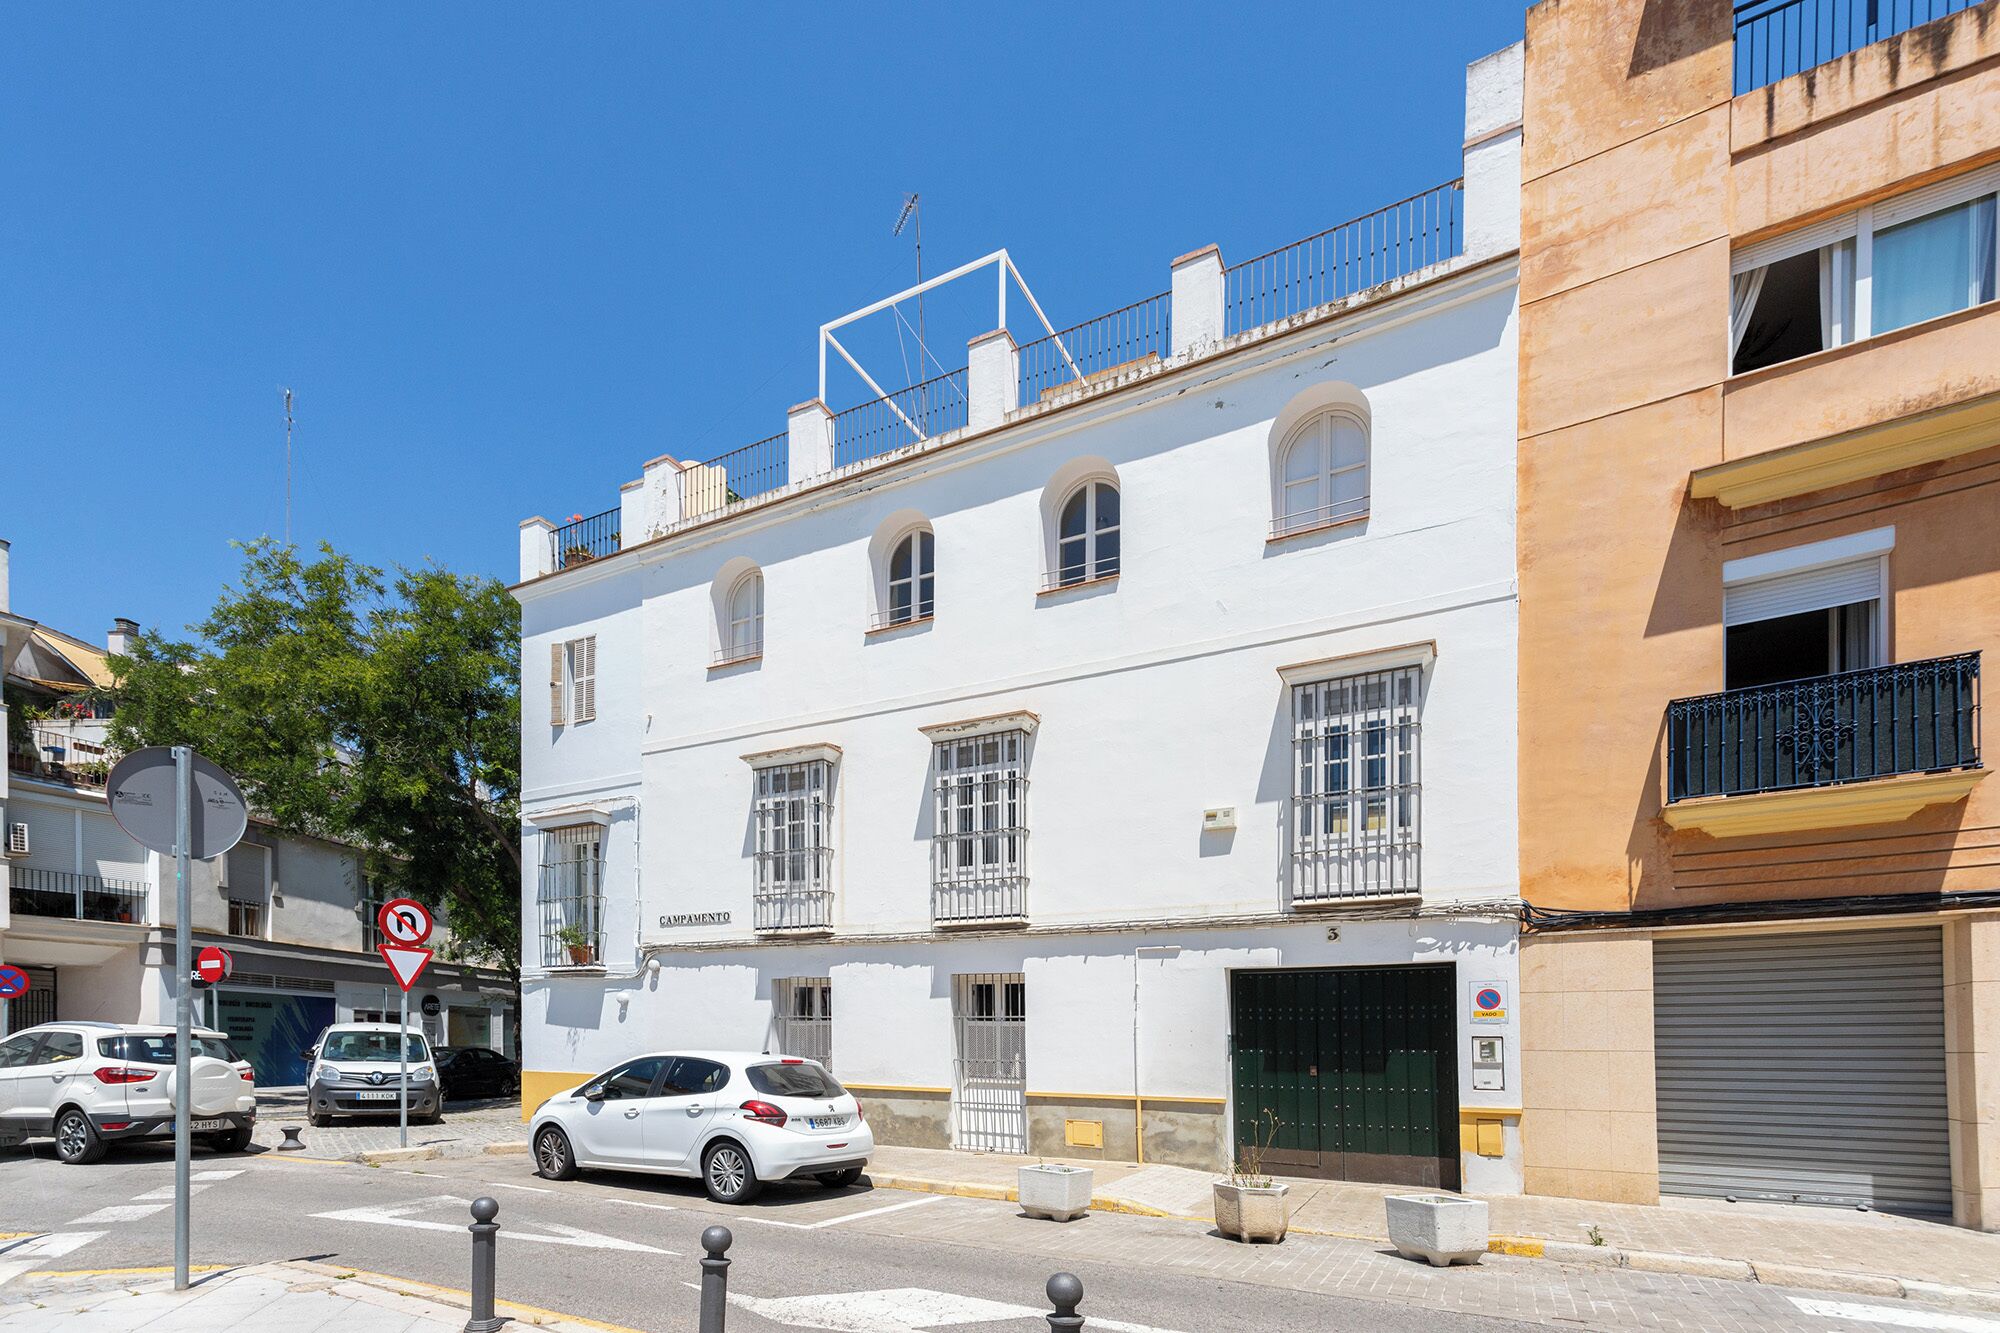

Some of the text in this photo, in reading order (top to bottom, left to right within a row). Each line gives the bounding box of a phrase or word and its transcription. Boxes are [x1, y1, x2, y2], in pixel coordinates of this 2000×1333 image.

[659, 911, 730, 925] CAMPAMENTO
[1328, 927, 1339, 941] 3
[201, 1120, 218, 1128] HYS
[815, 1118, 832, 1127] 5687
